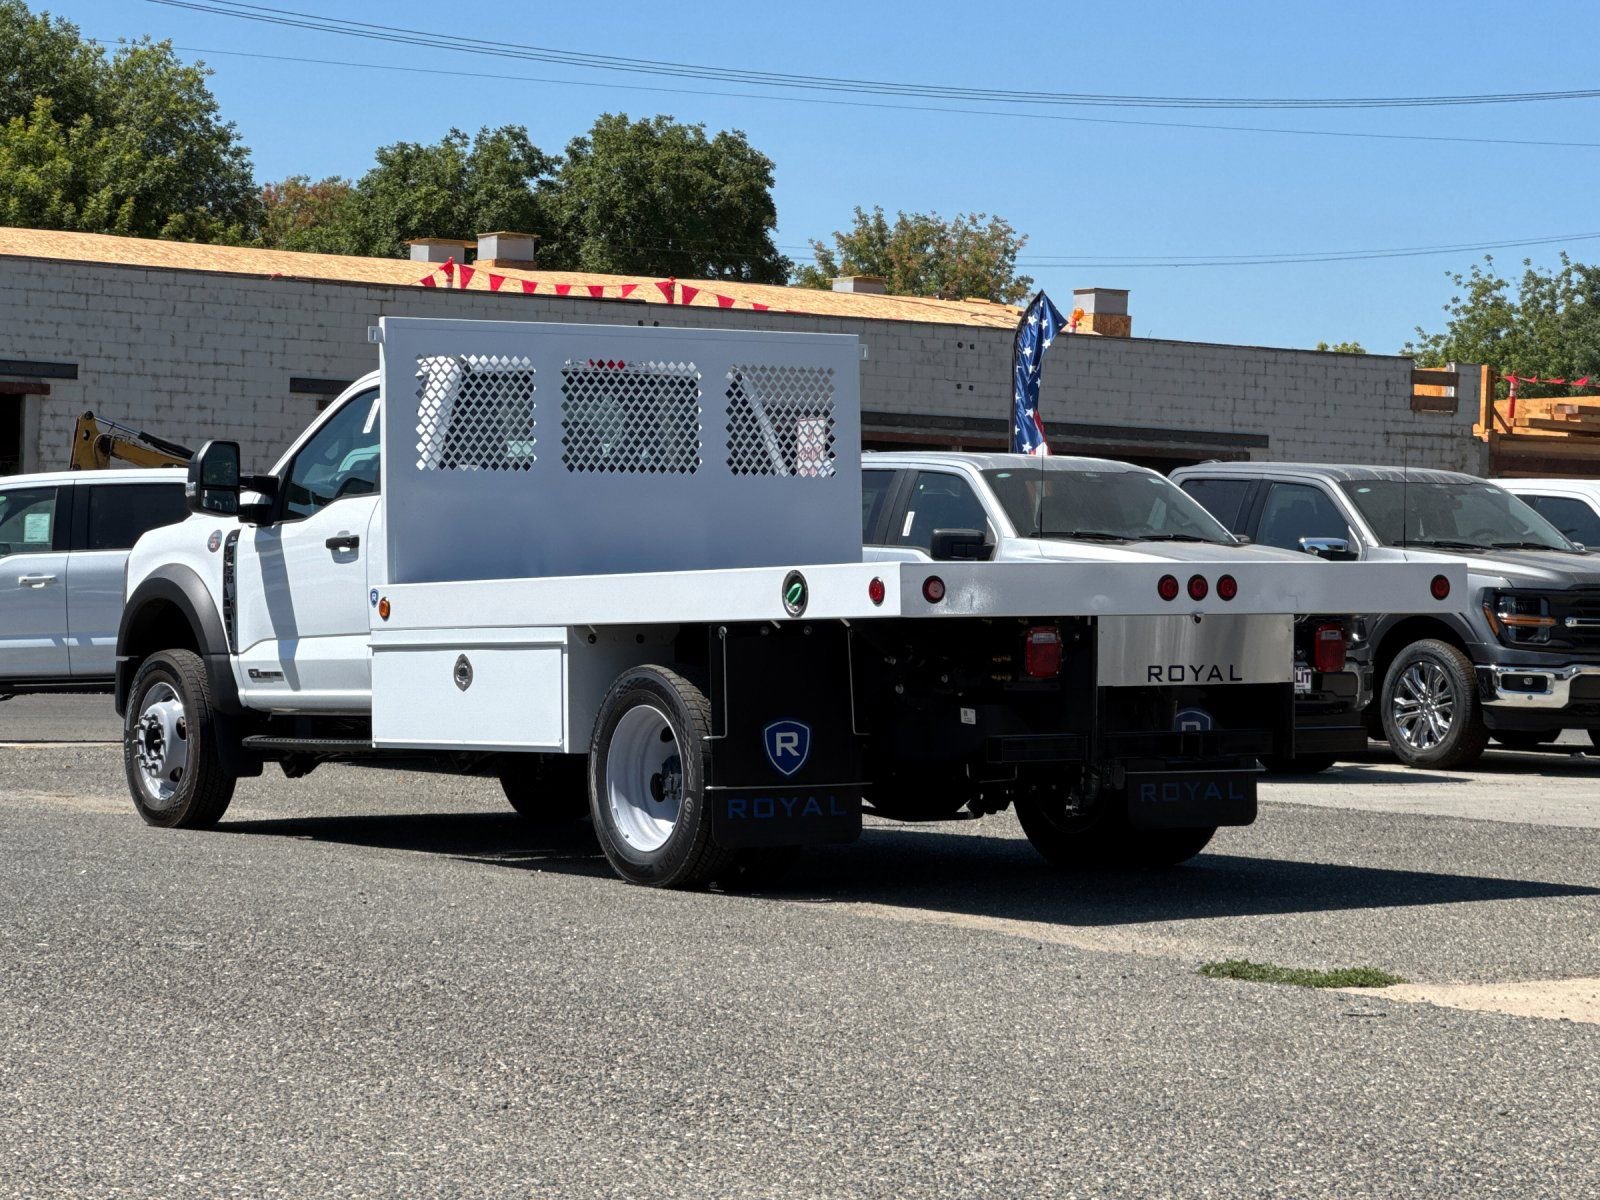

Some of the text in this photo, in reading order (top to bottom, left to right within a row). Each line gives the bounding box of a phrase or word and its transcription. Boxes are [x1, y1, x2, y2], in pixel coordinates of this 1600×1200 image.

[1147, 664, 1243, 682] ROYAL
[775, 732, 800, 757] R
[1139, 781, 1244, 802] ROYAL
[727, 796, 847, 819] ROYAL
